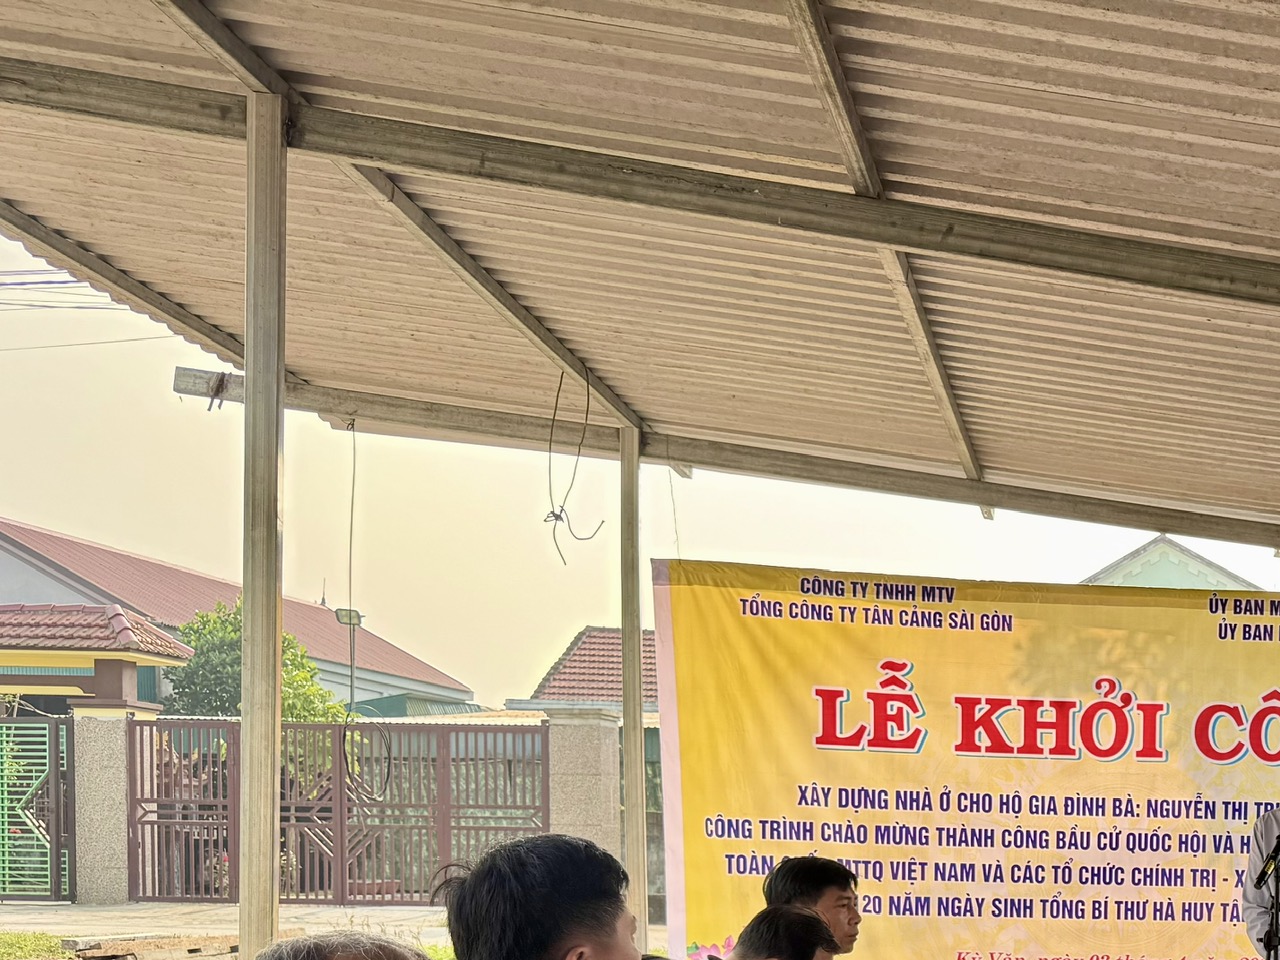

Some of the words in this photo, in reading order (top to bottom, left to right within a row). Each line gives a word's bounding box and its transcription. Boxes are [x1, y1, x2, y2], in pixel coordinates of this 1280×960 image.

[801, 575, 845, 596] CÔNG
[850, 581, 869, 598] TY
[874, 583, 916, 601] TNHH
[922, 586, 955, 603] MTV
[1209, 592, 1228, 614] ỦY
[1233, 599, 1264, 615] BAN
[740, 593, 782, 617] TỔNG
[789, 600, 833, 621] CÔNG
[839, 606, 857, 622] TY
[863, 605, 893, 625] TÂN
[899, 605, 942, 628] CẢNG
[949, 609, 974, 630] SÀI
[981, 610, 1012, 631] GÒN
[1219, 618, 1237, 640] ỦY
[1243, 624, 1273, 641] BAN
[814, 660, 925, 753] LỄ
[954, 677, 1169, 762] KHỞI
[798, 782, 831, 807] XÂY
[839, 787, 888, 813] DỰNG
[896, 787, 933, 811] NHÀ
[940, 785, 951, 811] Ở
[958, 793, 992, 813] CHO
[1000, 791, 1022, 818] HỘ
[1029, 795, 1057, 815] GIA
[1064, 793, 1105, 816] ĐÌNH
[1113, 794, 1140, 817] BÀ:
[1147, 793, 1216, 819] NGUYỄN
[1222, 801, 1248, 824] THỊ
[706, 814, 752, 838] CÔNG
[759, 816, 813, 841] TRÌNH
[821, 820, 867, 844] CHÀO
[875, 822, 929, 845] MỪNG
[936, 824, 994, 847] THÀNH
[1002, 825, 1049, 849] CÔNG
[1056, 824, 1090, 850] BẦU
[1097, 826, 1122, 851] CỬ
[1126, 826, 1171, 853] QUỐC
[1179, 830, 1206, 858] HỘI
[1213, 831, 1234, 853] VÀ
[725, 851, 774, 875] TOÀN
[890, 858, 928, 885] VIỆT
[934, 863, 975, 882] NAM
[982, 860, 1004, 882] VÀ
[1011, 861, 1045, 883] CÁC
[1052, 858, 1073, 884] TỔ
[1079, 863, 1124, 885] CHỨC
[1132, 864, 1184, 886] CHÍNH
[1190, 869, 1216, 892] TRỊ
[857, 895, 882, 914] 20
[889, 890, 930, 916] NĂM
[938, 893, 985, 917] NGÀY
[992, 898, 1033, 918] SINH
[1040, 891, 1085, 919] TỔNG
[1092, 896, 1108, 919] BÍ
[1115, 899, 1148, 920] THƯ
[1153, 898, 1175, 921] HÀ
[1182, 902, 1214, 921] HUY
[1220, 899, 1246, 926] TẬ
